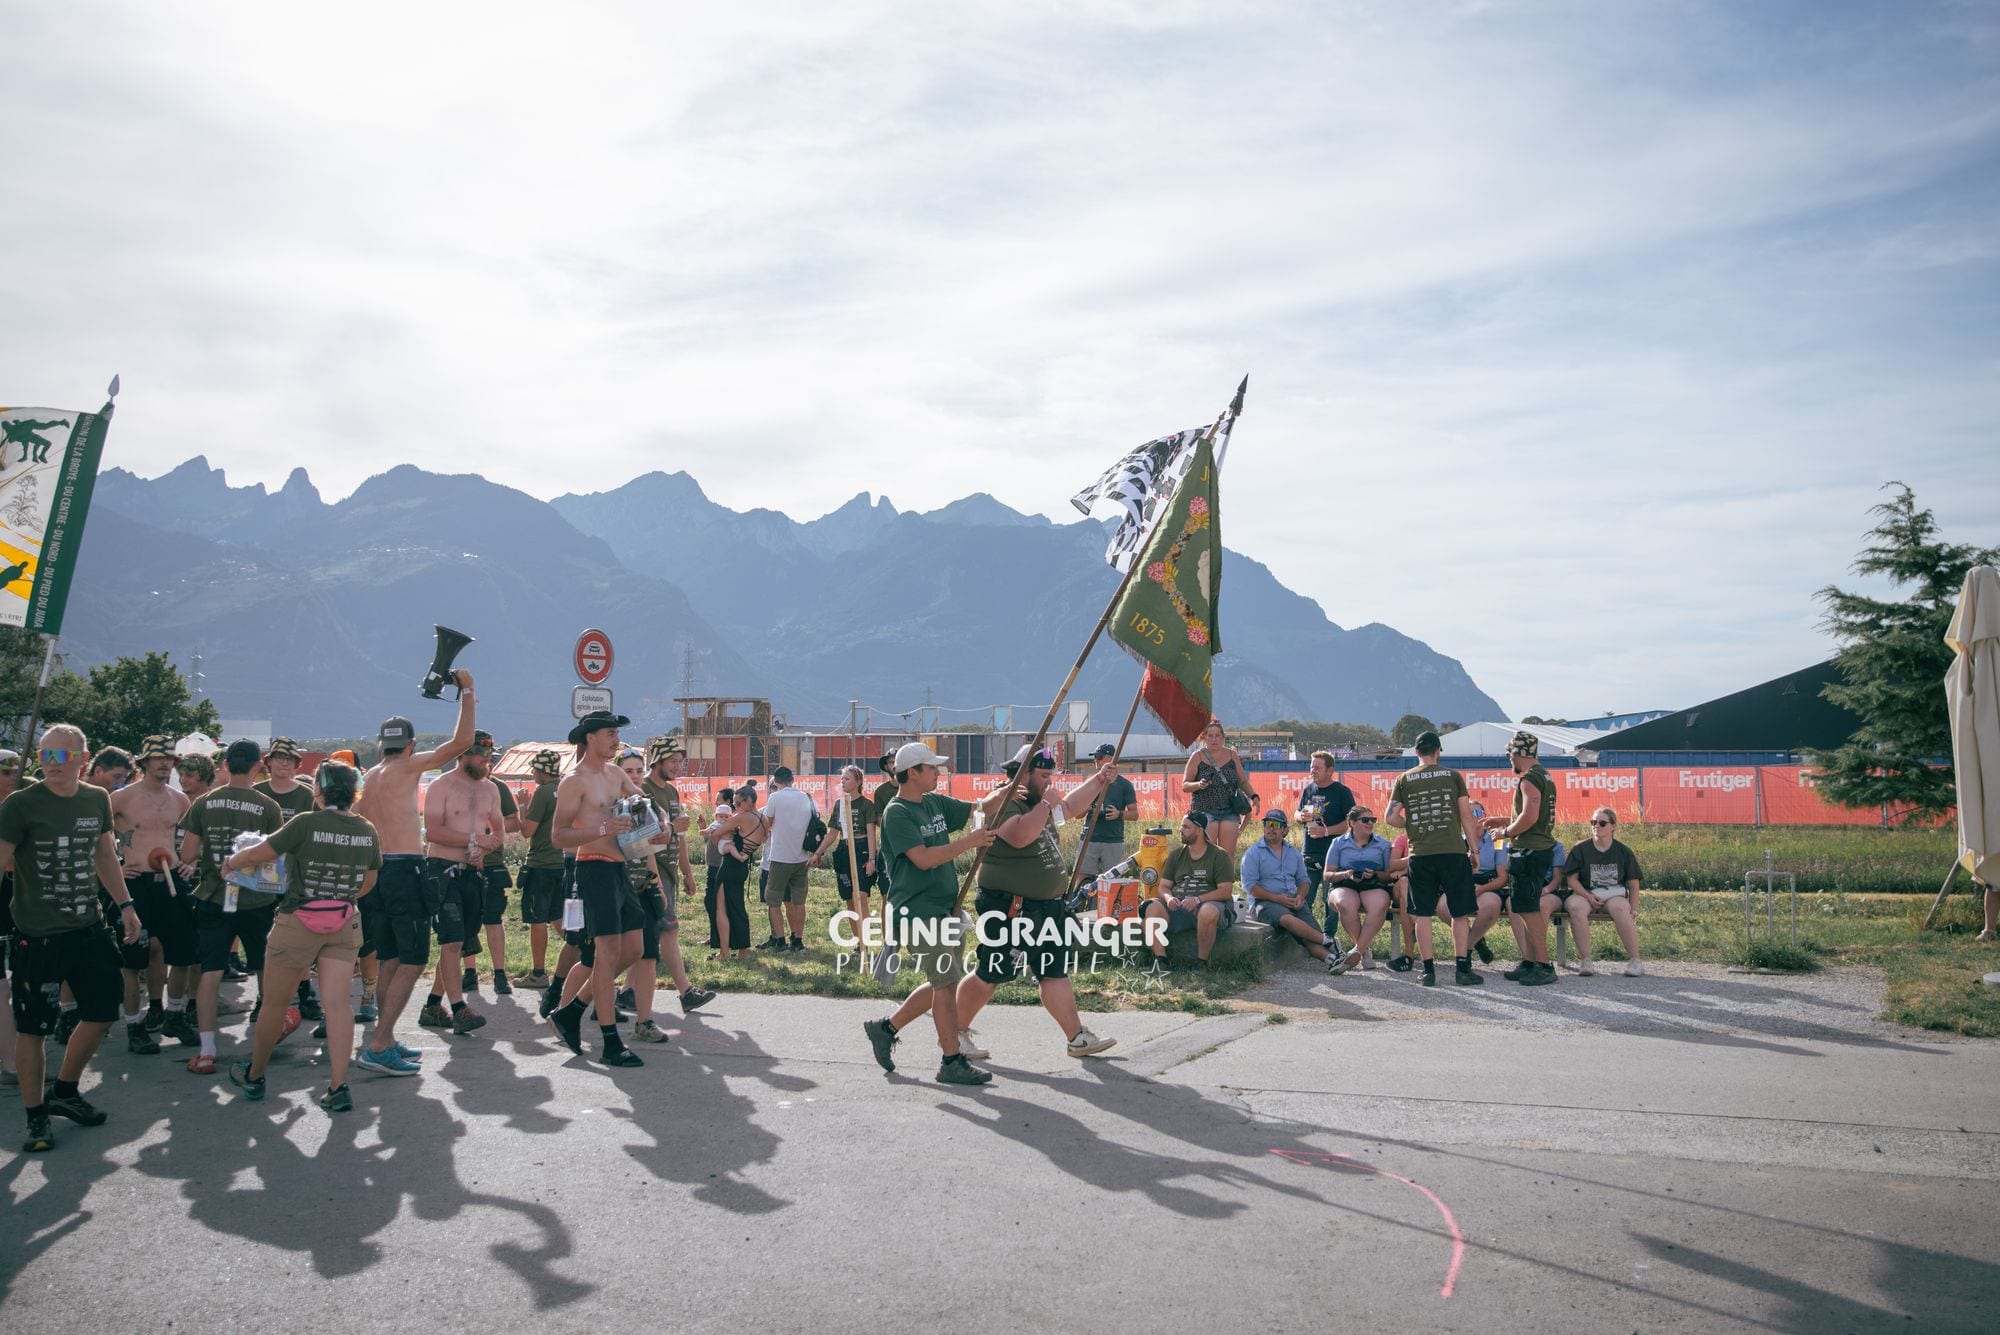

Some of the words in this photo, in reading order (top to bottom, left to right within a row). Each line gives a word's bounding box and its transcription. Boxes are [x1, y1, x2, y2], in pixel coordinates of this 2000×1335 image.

[63, 485, 74, 497] DU
[55, 498, 71, 525] CENTRE
[52, 529, 64, 540] DU
[47, 541, 61, 562] NORD
[43, 567, 55, 578] DU
[39, 579, 52, 596] PIED
[37, 597, 49, 608] DU
[33, 608, 47, 628] JURA
[1129, 612, 1166, 645] 1875
[1420, 771, 1433, 779] DES
[1465, 773, 1519, 793] Frutige
[1565, 772, 1637, 793] Frutiger
[1679, 770, 1753, 792] Frutiger
[675, 780, 708, 793] Frutiger
[1132, 777, 1164, 794] tiger
[206, 799, 226, 809] NAIN
[226, 799, 240, 810] DES
[240, 801, 265, 816] MINES
[313, 831, 334, 844] NAIN
[334, 833, 350, 846] DES
[350, 836, 373, 847] MINES
